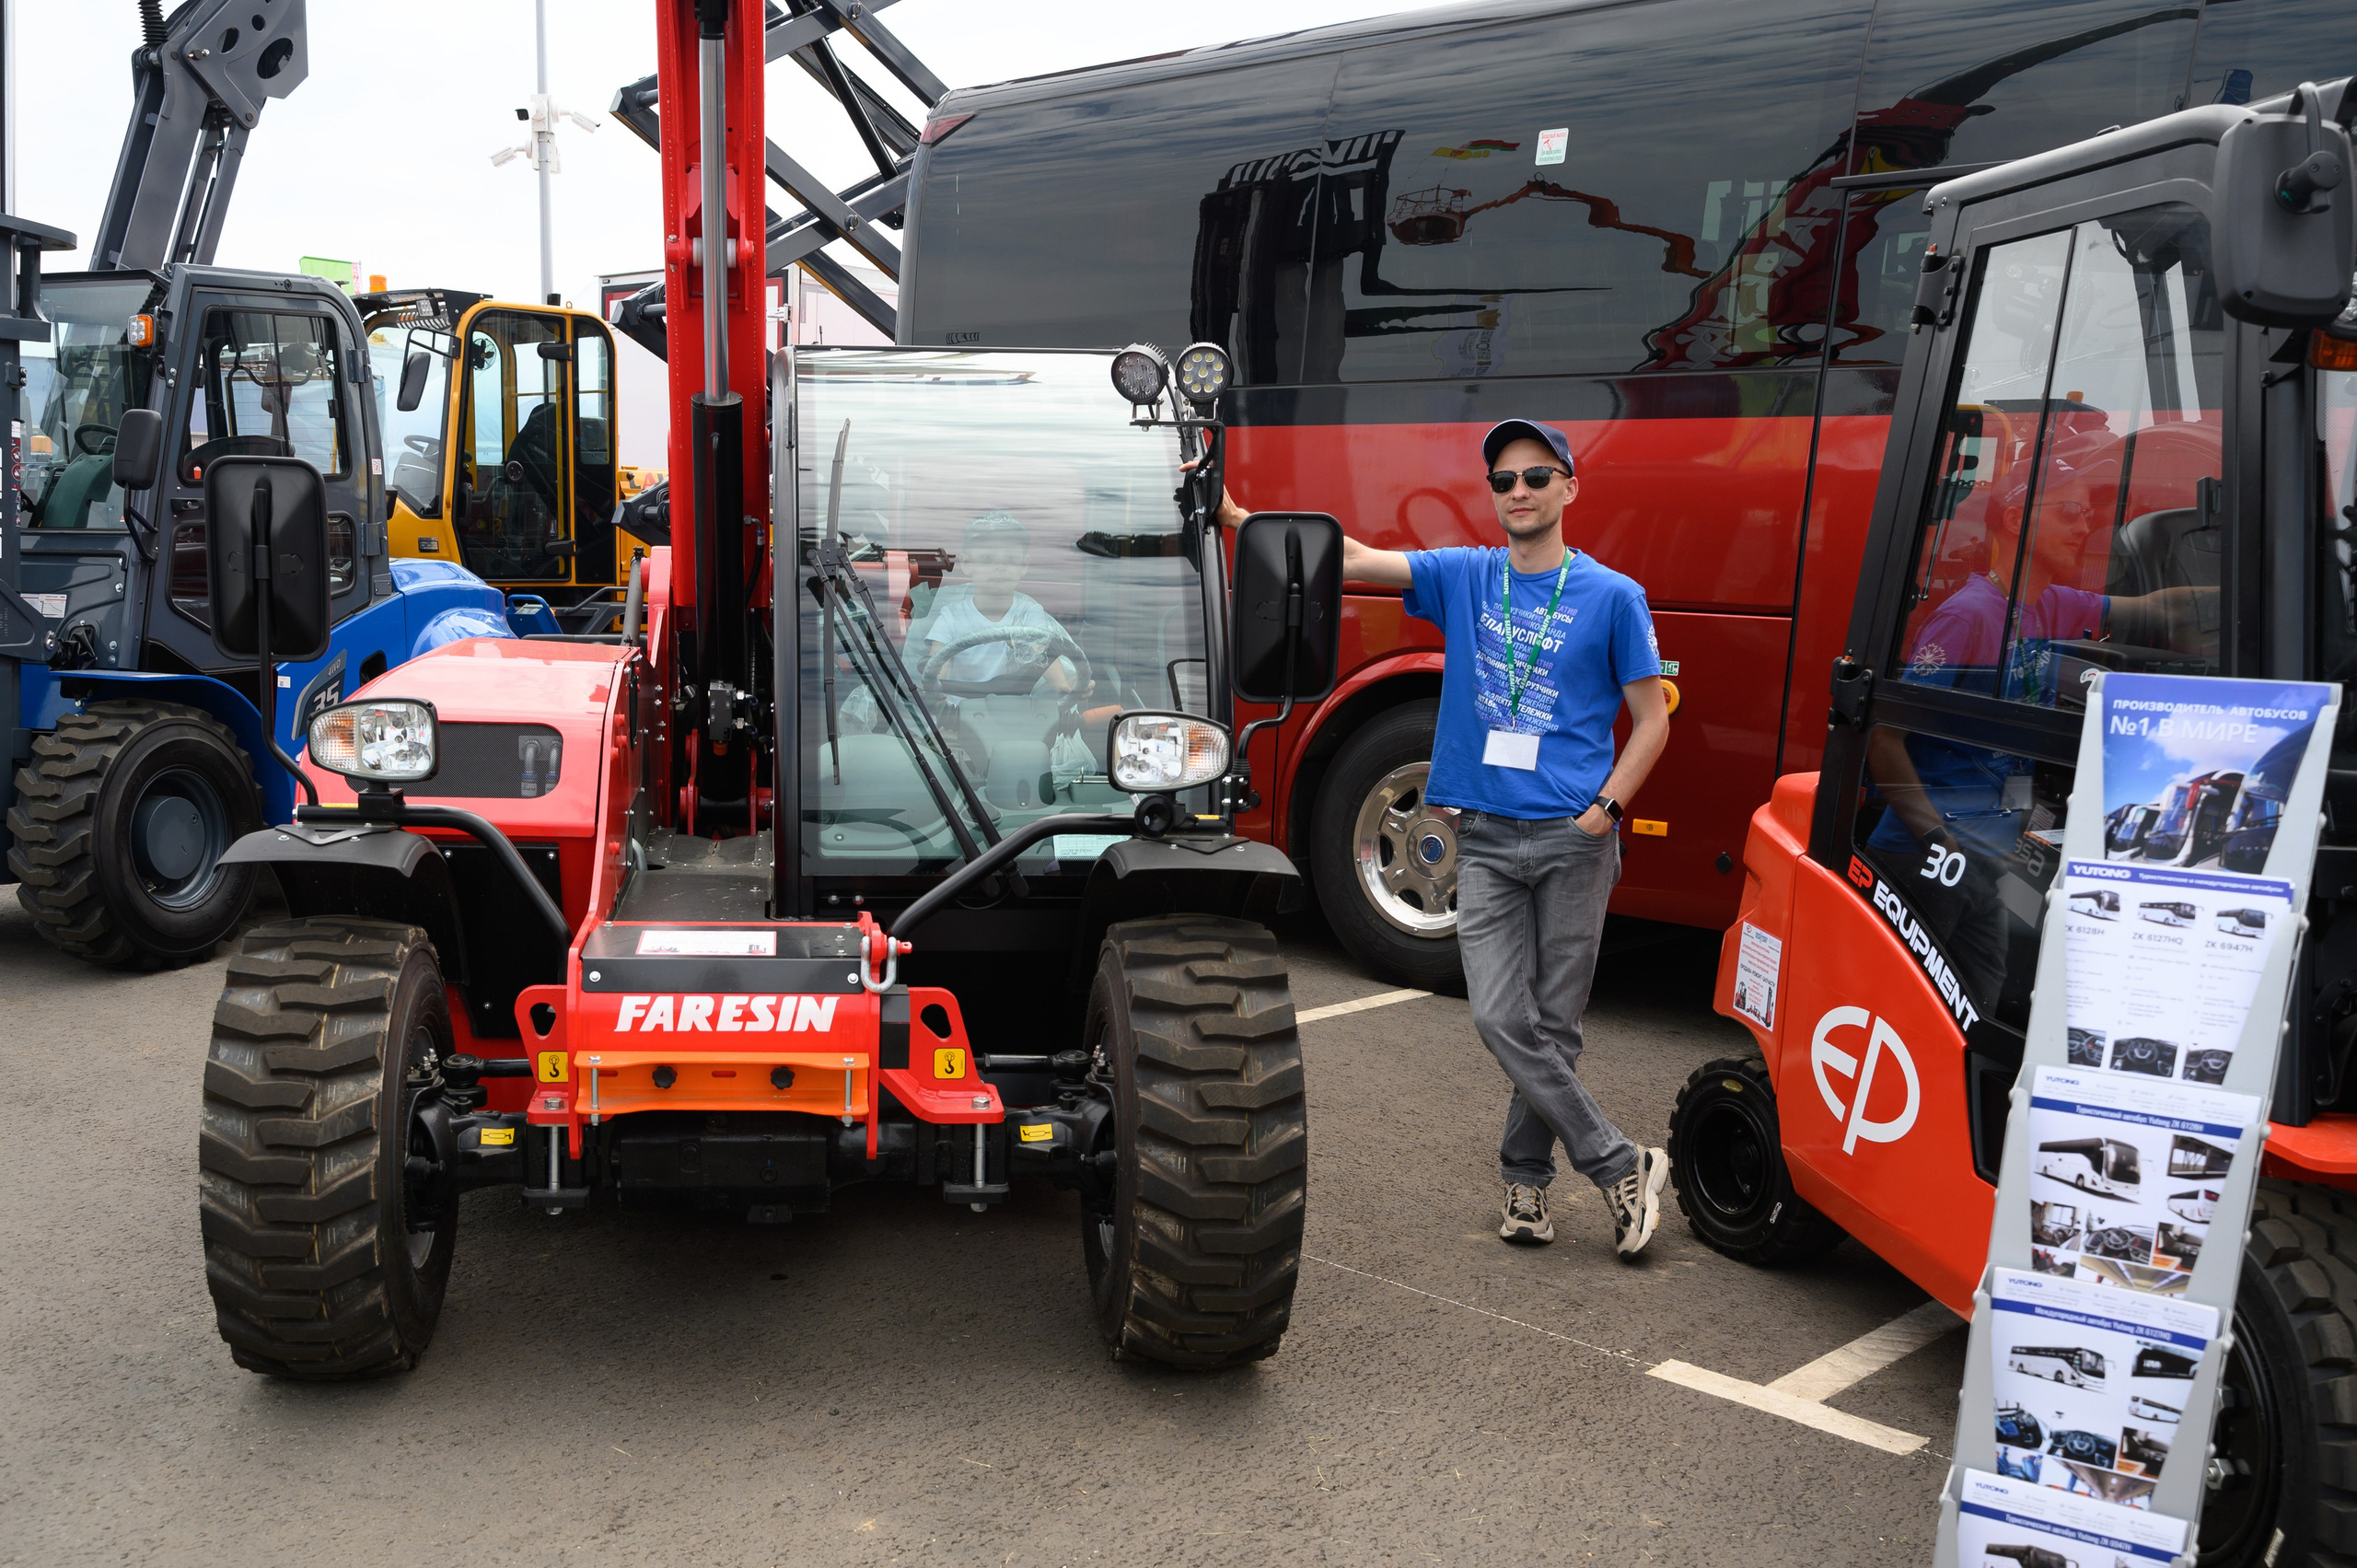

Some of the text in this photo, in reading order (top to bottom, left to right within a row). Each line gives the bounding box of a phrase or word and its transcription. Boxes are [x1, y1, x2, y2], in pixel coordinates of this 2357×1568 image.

[1533, 606, 1574, 624] АВТБУСЫ
[1515, 677, 1559, 699] ПОРУЗЧИКИ
[1491, 692, 1553, 722] ЭЛЕКТРТЕЛЕЖКИ
[2112, 698, 2308, 721] ПРОИЗВОДИТЕЛЬ АВТОБУСОВ
[2109, 715, 2259, 744] №1 В МИРЕ
[1920, 842, 1967, 888] 30
[2072, 865, 2131, 879] YUTONG
[1847, 854, 1980, 1031] EP EQUIPMENT
[2132, 932, 2143, 941] ZK
[2204, 940, 2217, 949] ZK
[614, 995, 840, 1032] FARESIN
[2045, 1074, 2080, 1086] YUTONG
[2007, 1277, 2043, 1288] YUTONG
